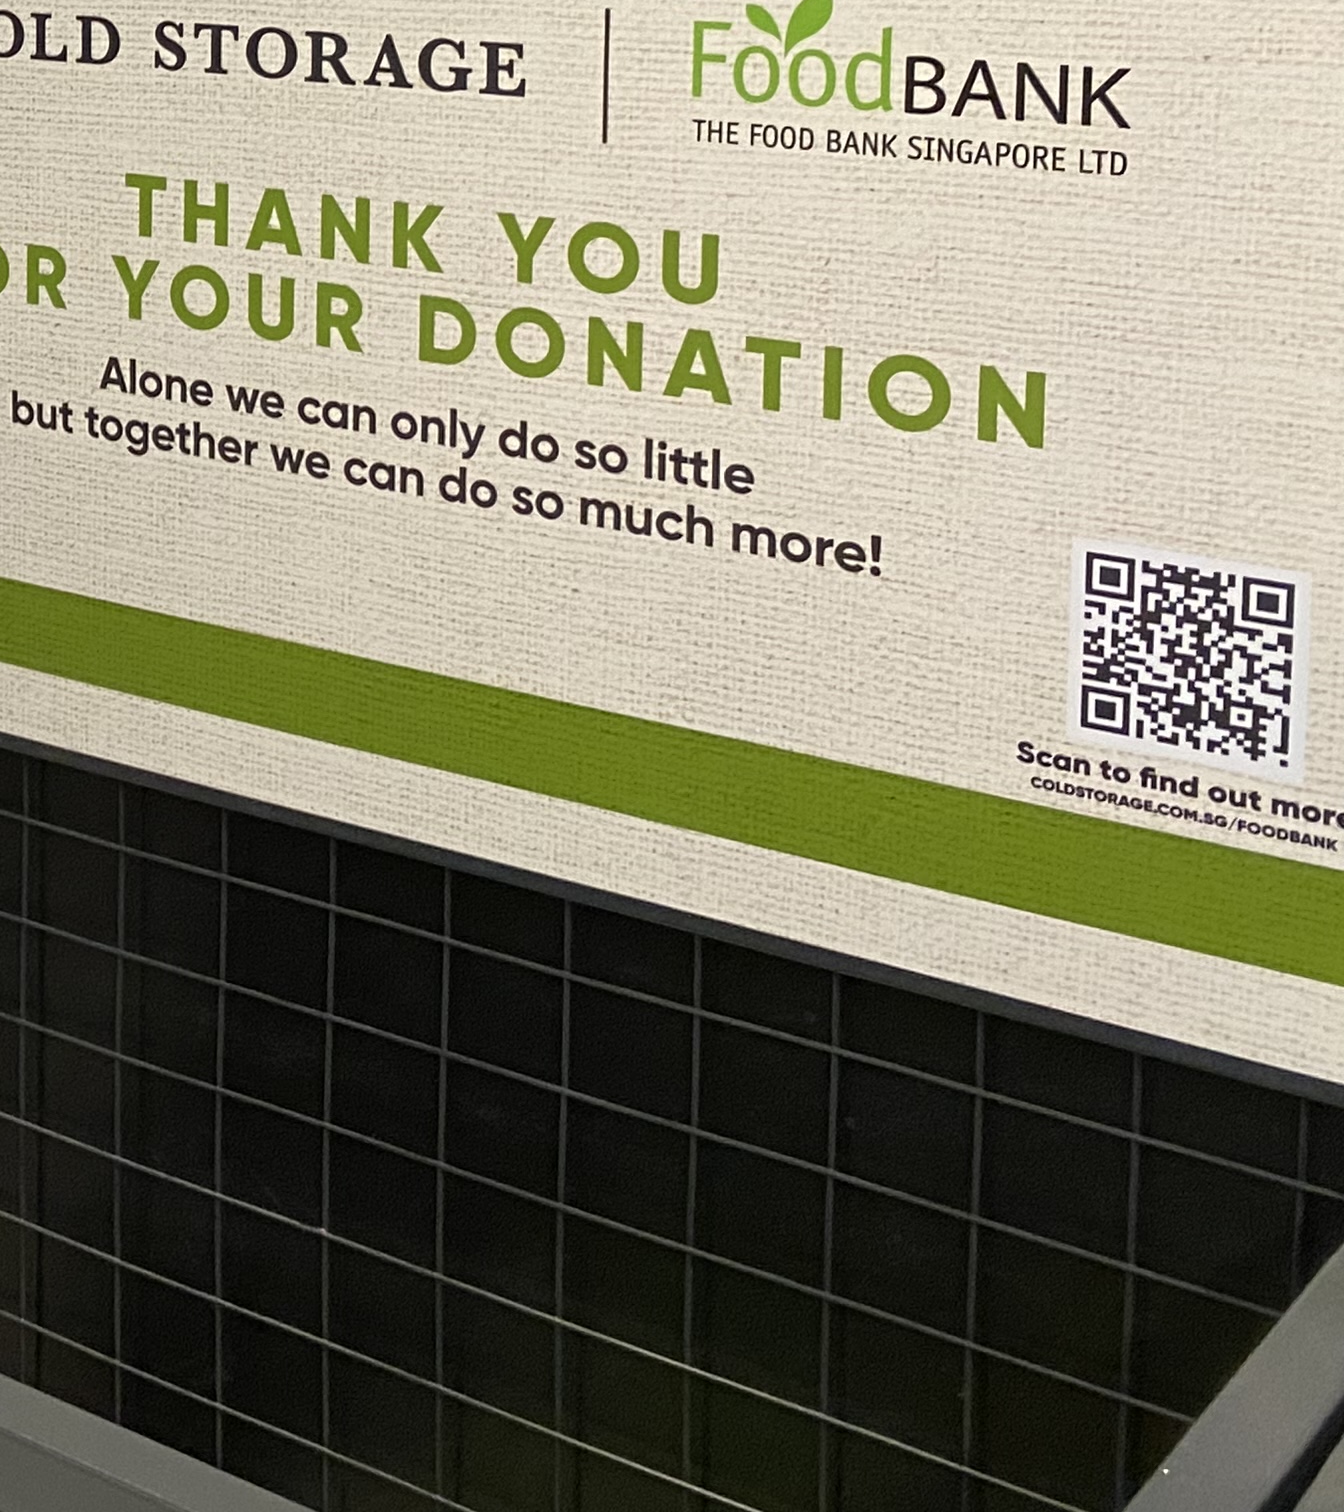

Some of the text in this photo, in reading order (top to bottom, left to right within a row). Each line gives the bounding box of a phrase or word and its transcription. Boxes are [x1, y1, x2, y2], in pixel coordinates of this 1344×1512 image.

[153, 20, 527, 98] STORAGE
[691, 19, 1132, 129] FoodBANK
[693, 118, 1128, 177] THE FOOD BANK SINGAPORE LTD
[124, 172, 720, 305] THANK YOU
[111, 254, 364, 353] YOUR
[419, 295, 1046, 450] DONATION
[99, 356, 756, 495] Alone we can only do so little
[12, 390, 884, 577] but together we can do so much more!
[1016, 740, 1091, 777] Scan
[1099, 759, 1131, 784] to
[1139, 767, 1200, 799] find
[1208, 785, 1262, 812] out
[1030, 776, 1339, 852] COLDSTORAGE.COM.SG/FOODBANK
